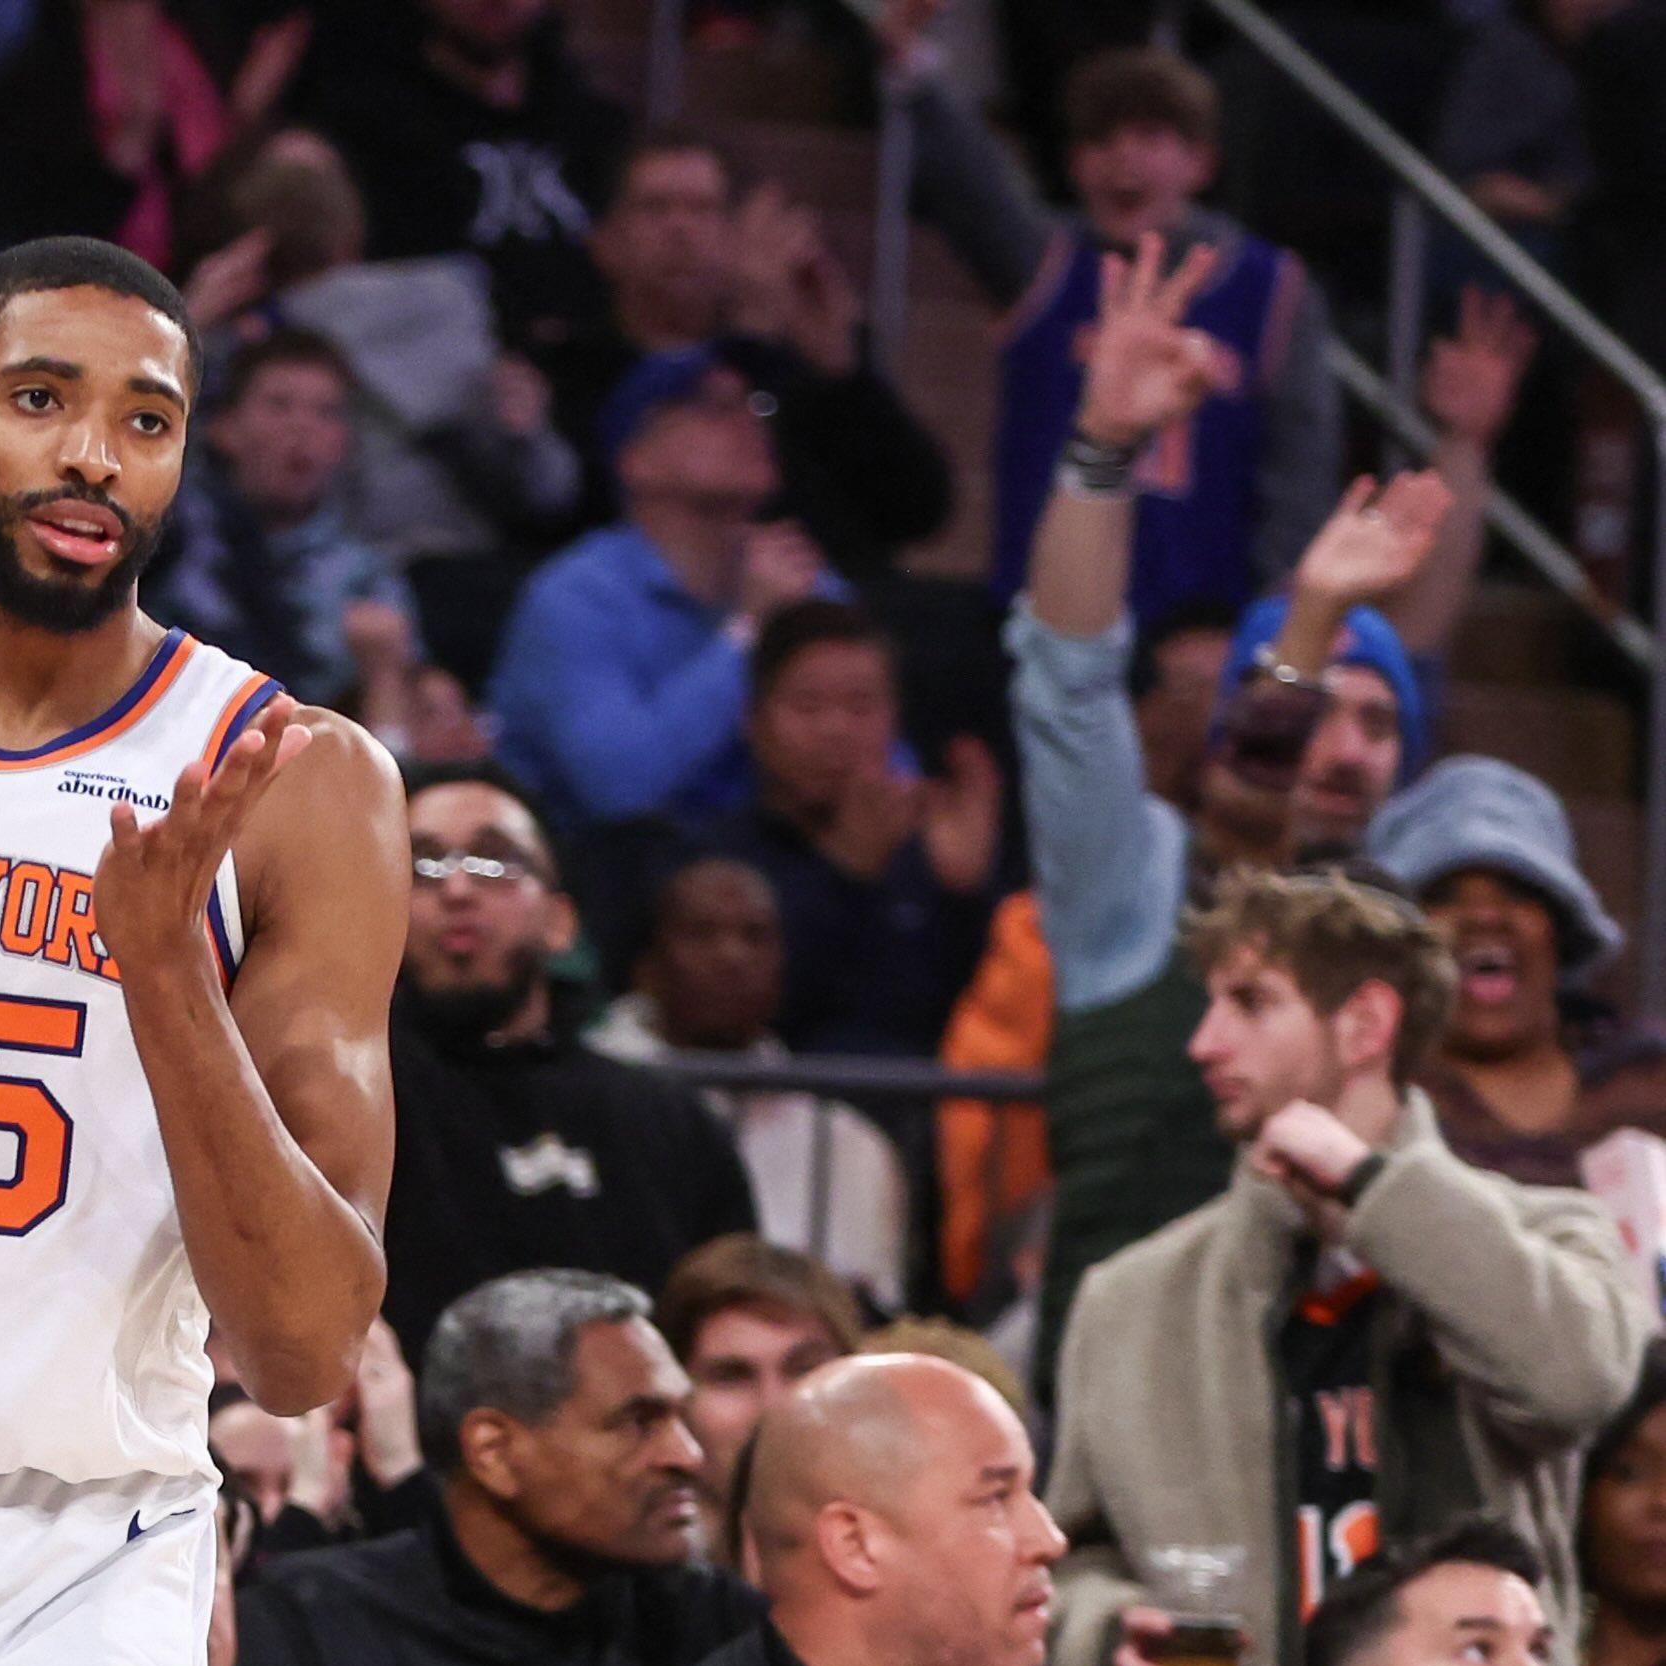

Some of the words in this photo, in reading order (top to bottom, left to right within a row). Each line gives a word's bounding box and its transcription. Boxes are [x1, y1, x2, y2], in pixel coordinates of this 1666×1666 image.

[63, 769, 128, 785] experience
[57, 779, 104, 798] abu
[108, 786, 170, 811] dhab
